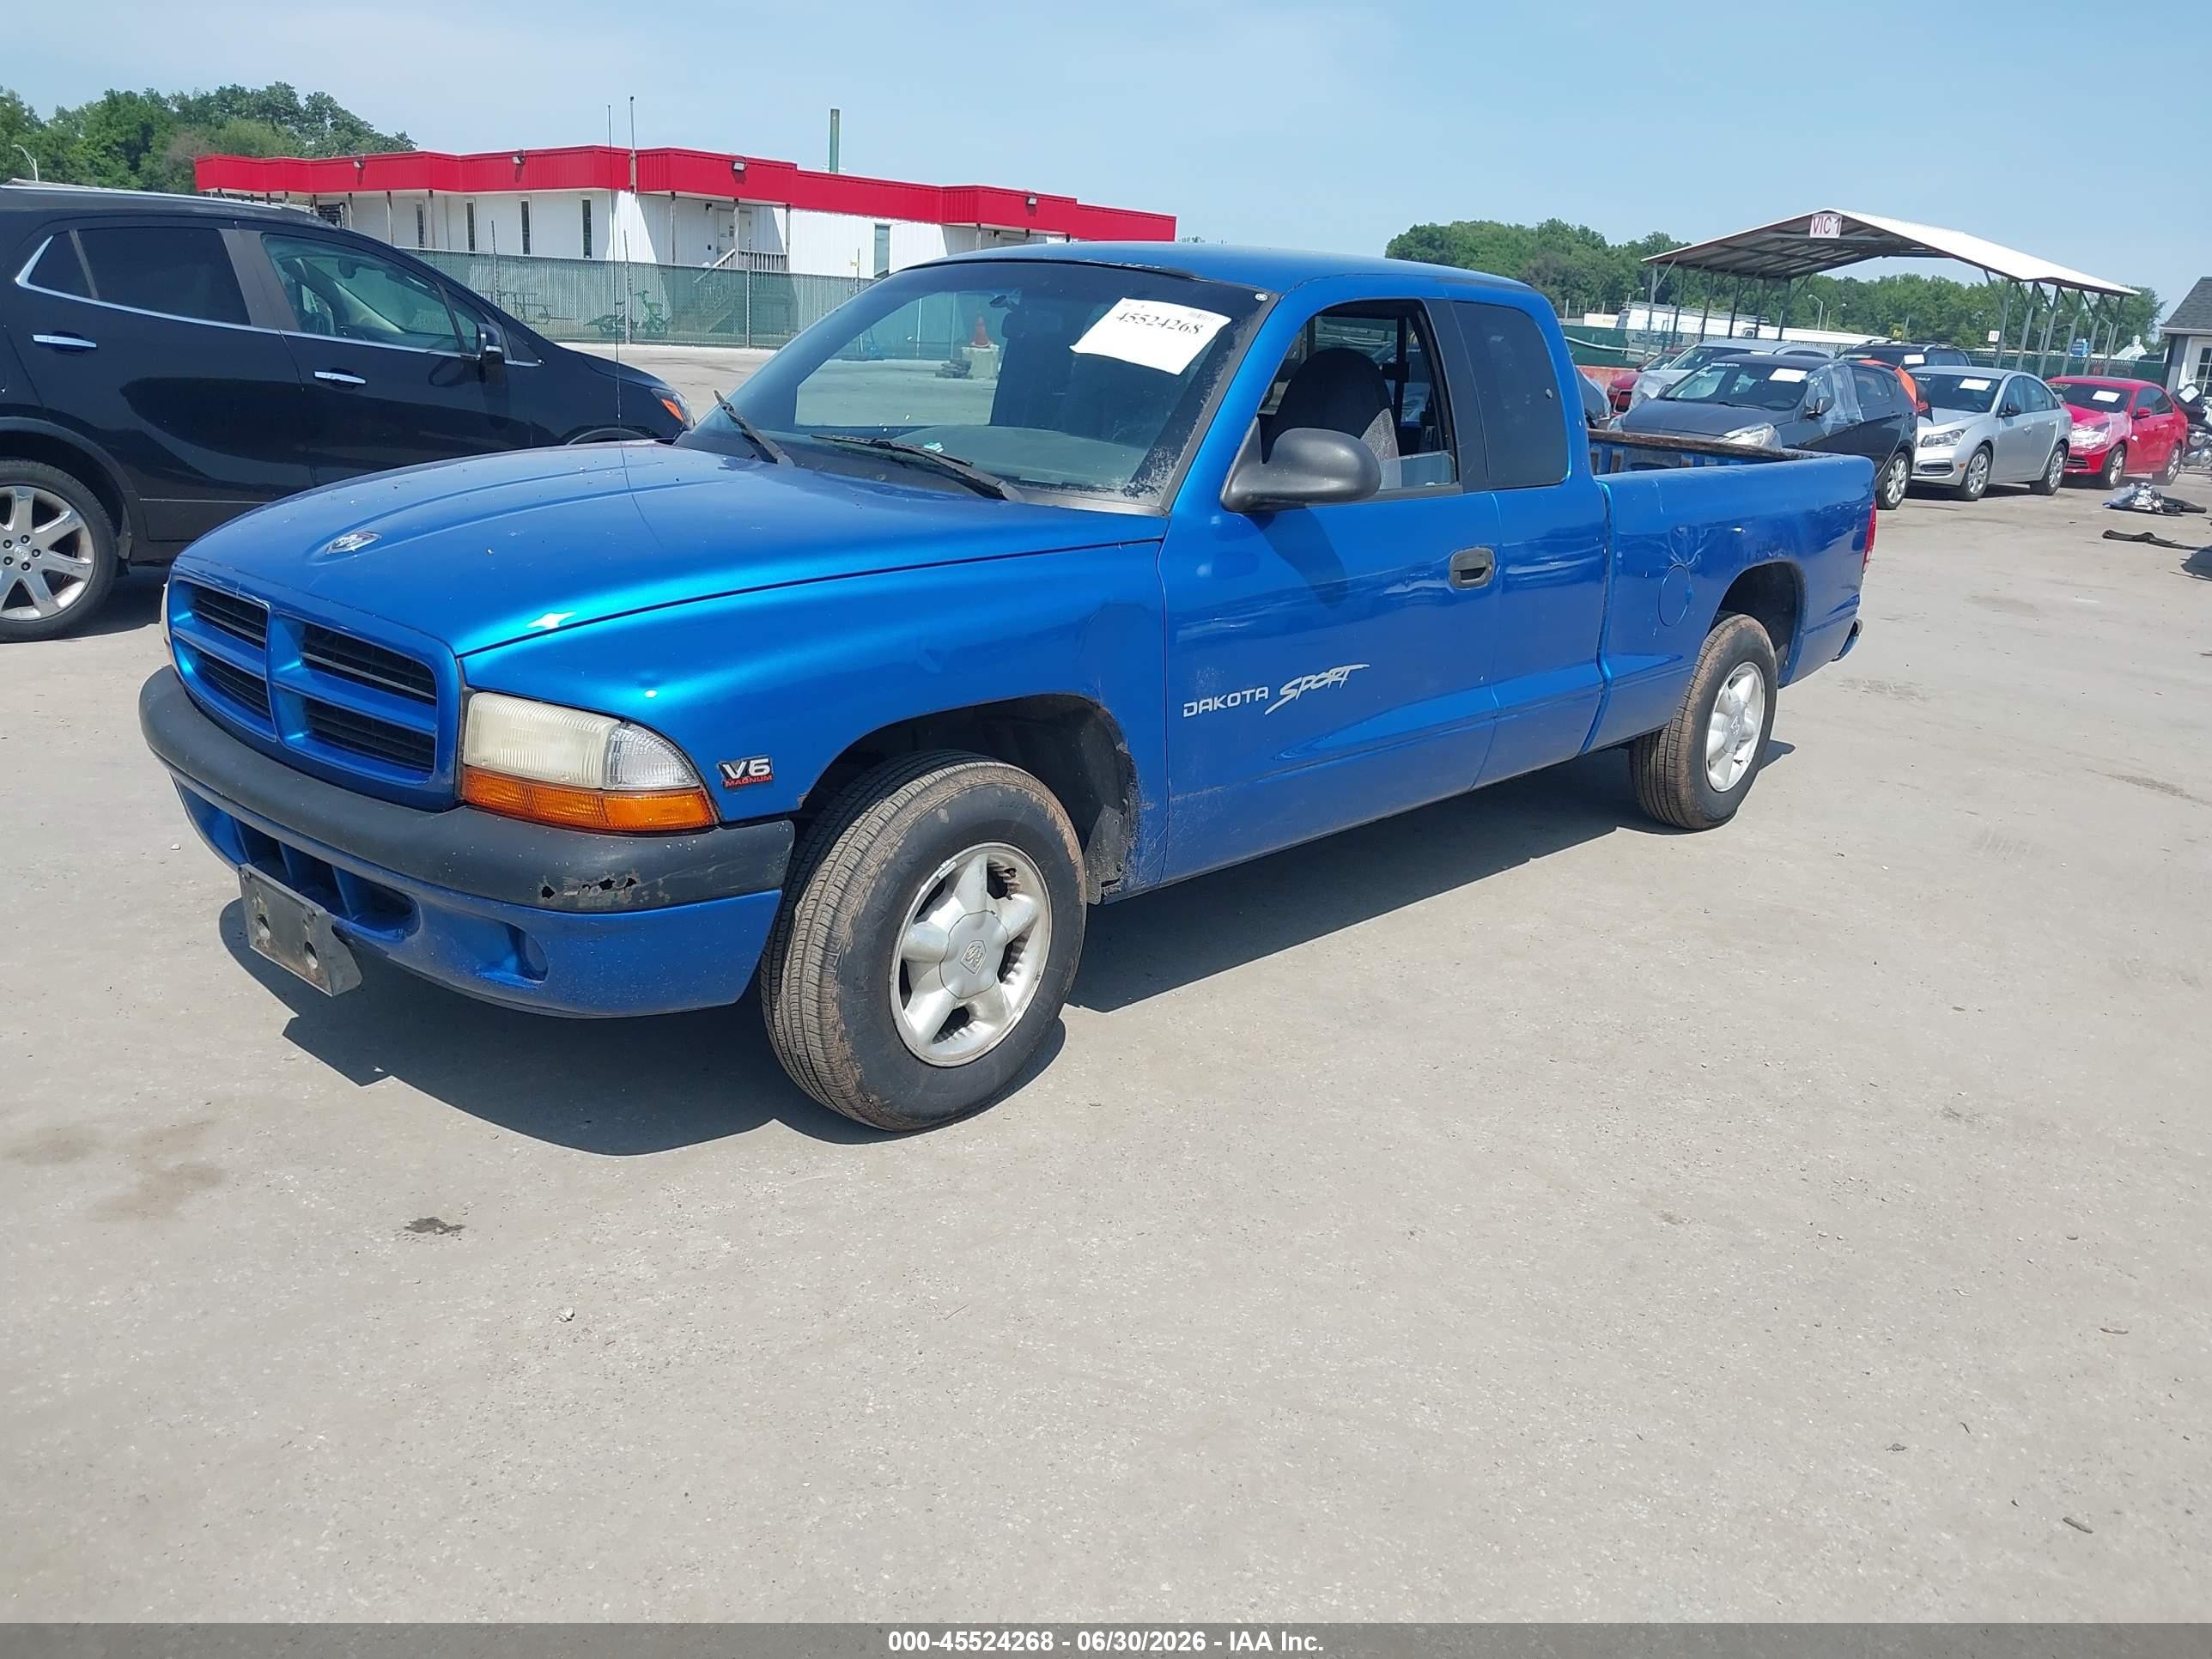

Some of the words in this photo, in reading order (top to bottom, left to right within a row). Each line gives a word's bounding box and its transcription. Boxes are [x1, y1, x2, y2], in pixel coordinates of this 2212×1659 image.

[1813, 216, 1832, 234] VIC
[1834, 217, 1841, 234] 1
[1115, 312, 1205, 335] 45524268
[1182, 686, 1269, 718] DAKOTA
[1264, 663, 1371, 715] SPORT
[722, 758, 771, 780] V6
[725, 775, 773, 787] MAGNUM
